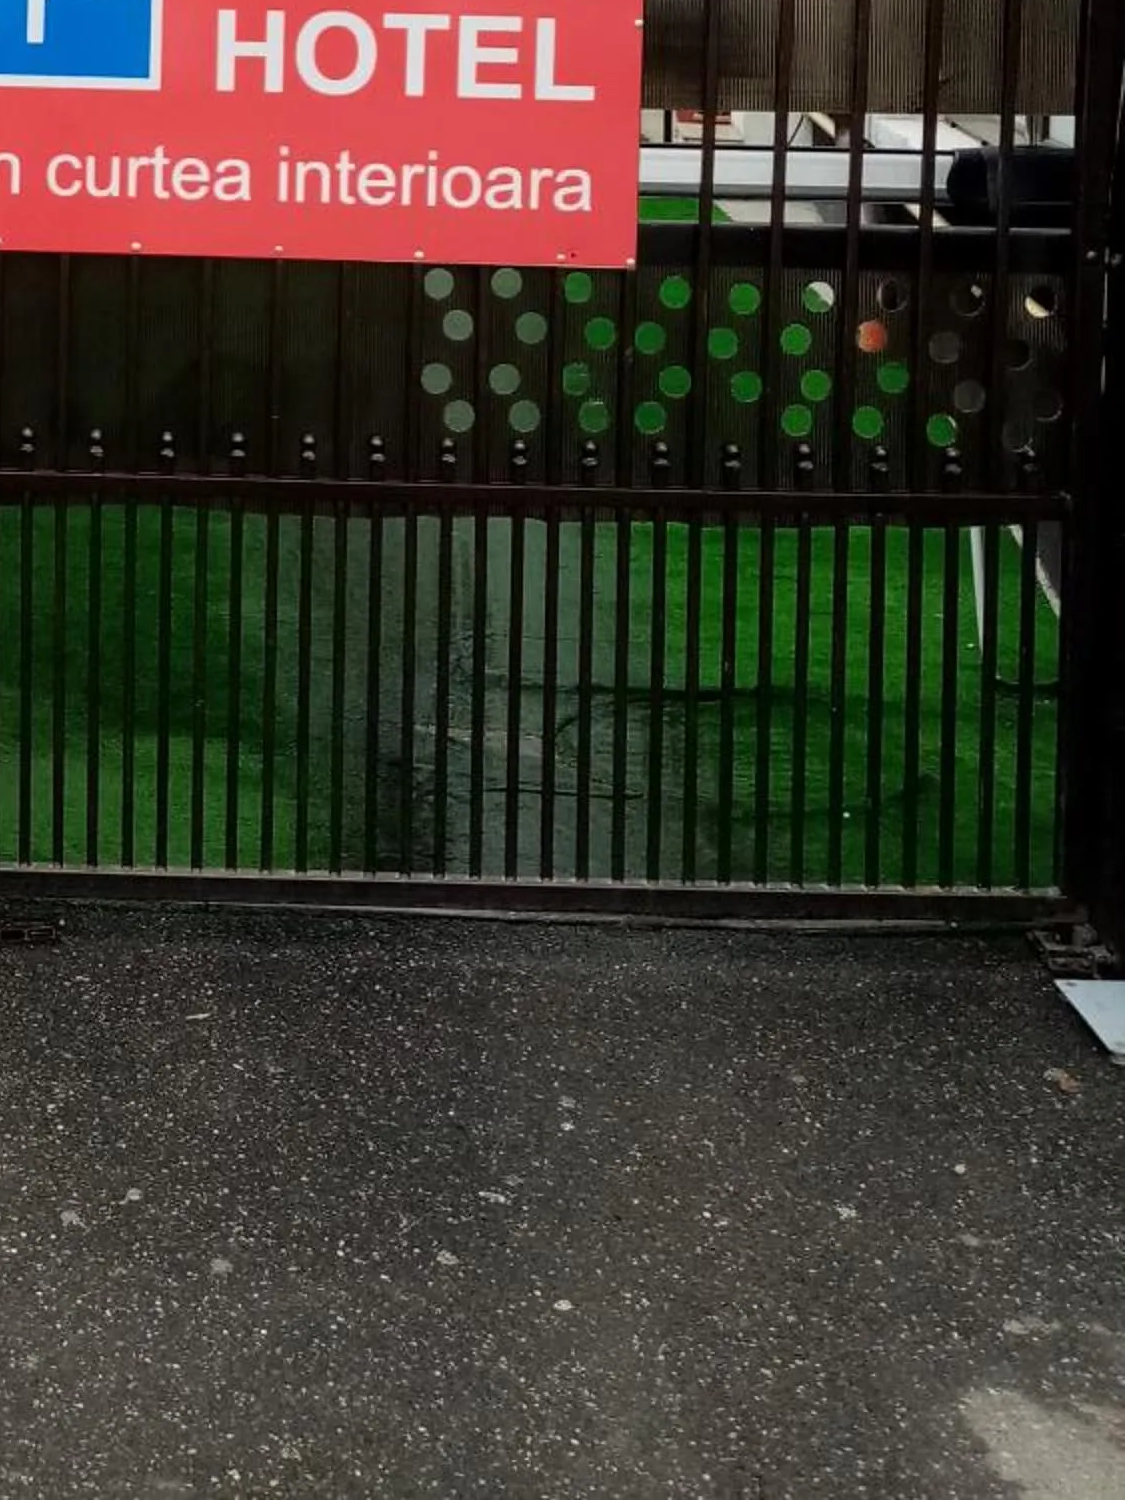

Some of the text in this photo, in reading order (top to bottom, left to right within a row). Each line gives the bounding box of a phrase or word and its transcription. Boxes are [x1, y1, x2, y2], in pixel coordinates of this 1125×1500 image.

[216, 8, 595, 101] HOTEL
[46, 145, 252, 201] curtea
[277, 146, 592, 212] interioara
